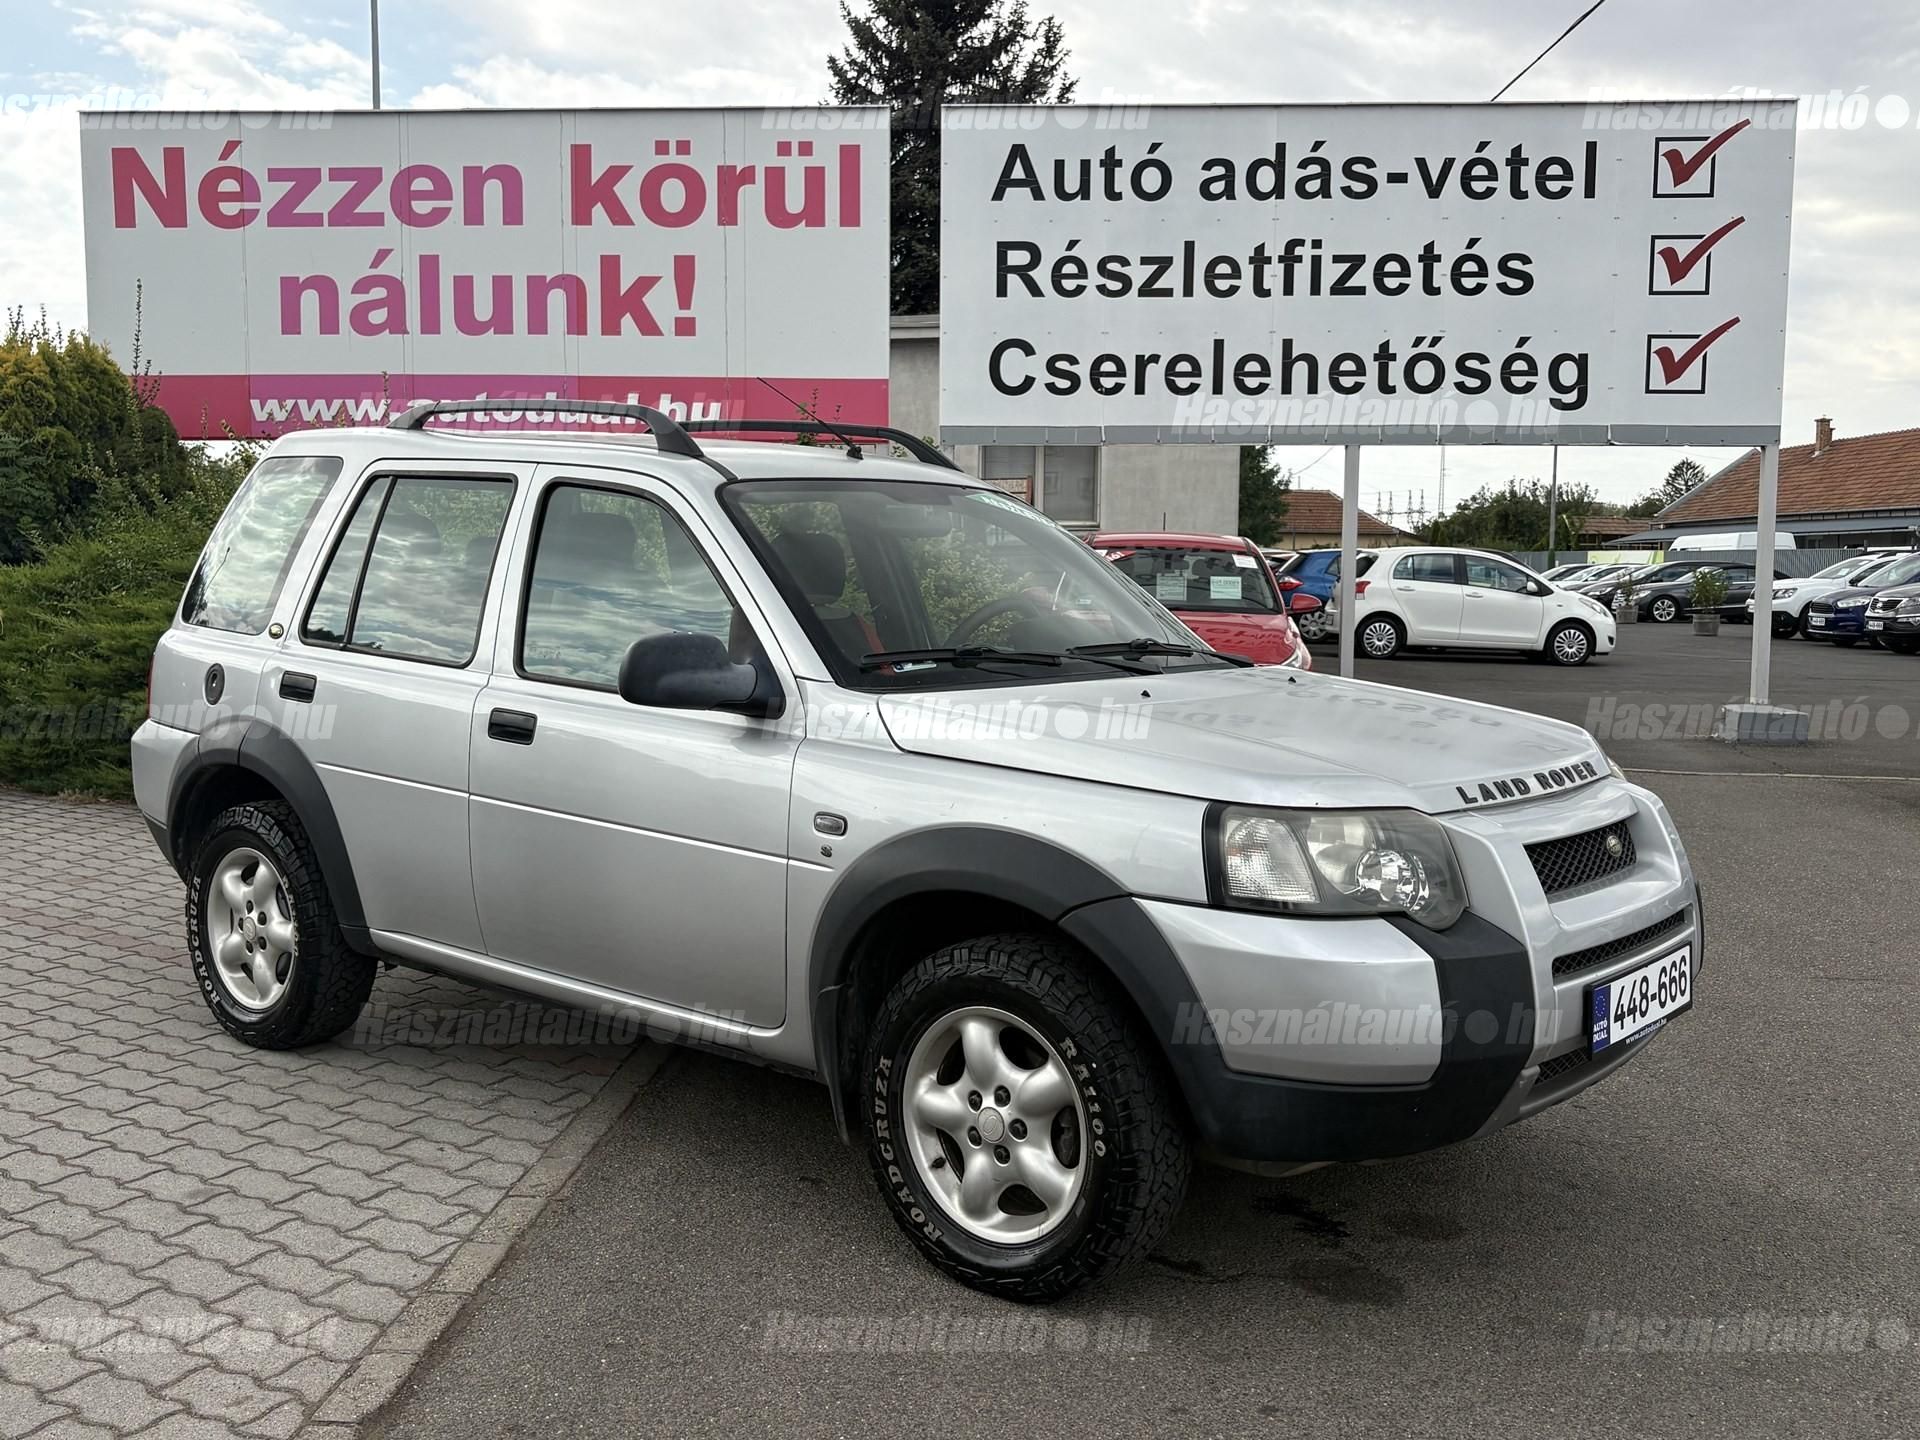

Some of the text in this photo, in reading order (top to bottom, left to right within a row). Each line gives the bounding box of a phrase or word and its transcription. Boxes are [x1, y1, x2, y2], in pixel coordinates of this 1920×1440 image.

[111, 140, 861, 229] Nézzen körül
[991, 141, 1598, 202] Autó adás-vétel
[280, 249, 697, 337] nálunk!
[996, 238, 1535, 299] Részletfizetés
[989, 335, 1589, 412] Cserelehetőség
[1455, 760, 1598, 805] LAND ROVER
[1613, 955, 1688, 1031] 448-666
[873, 1055, 944, 1242] ROADCRUZA
